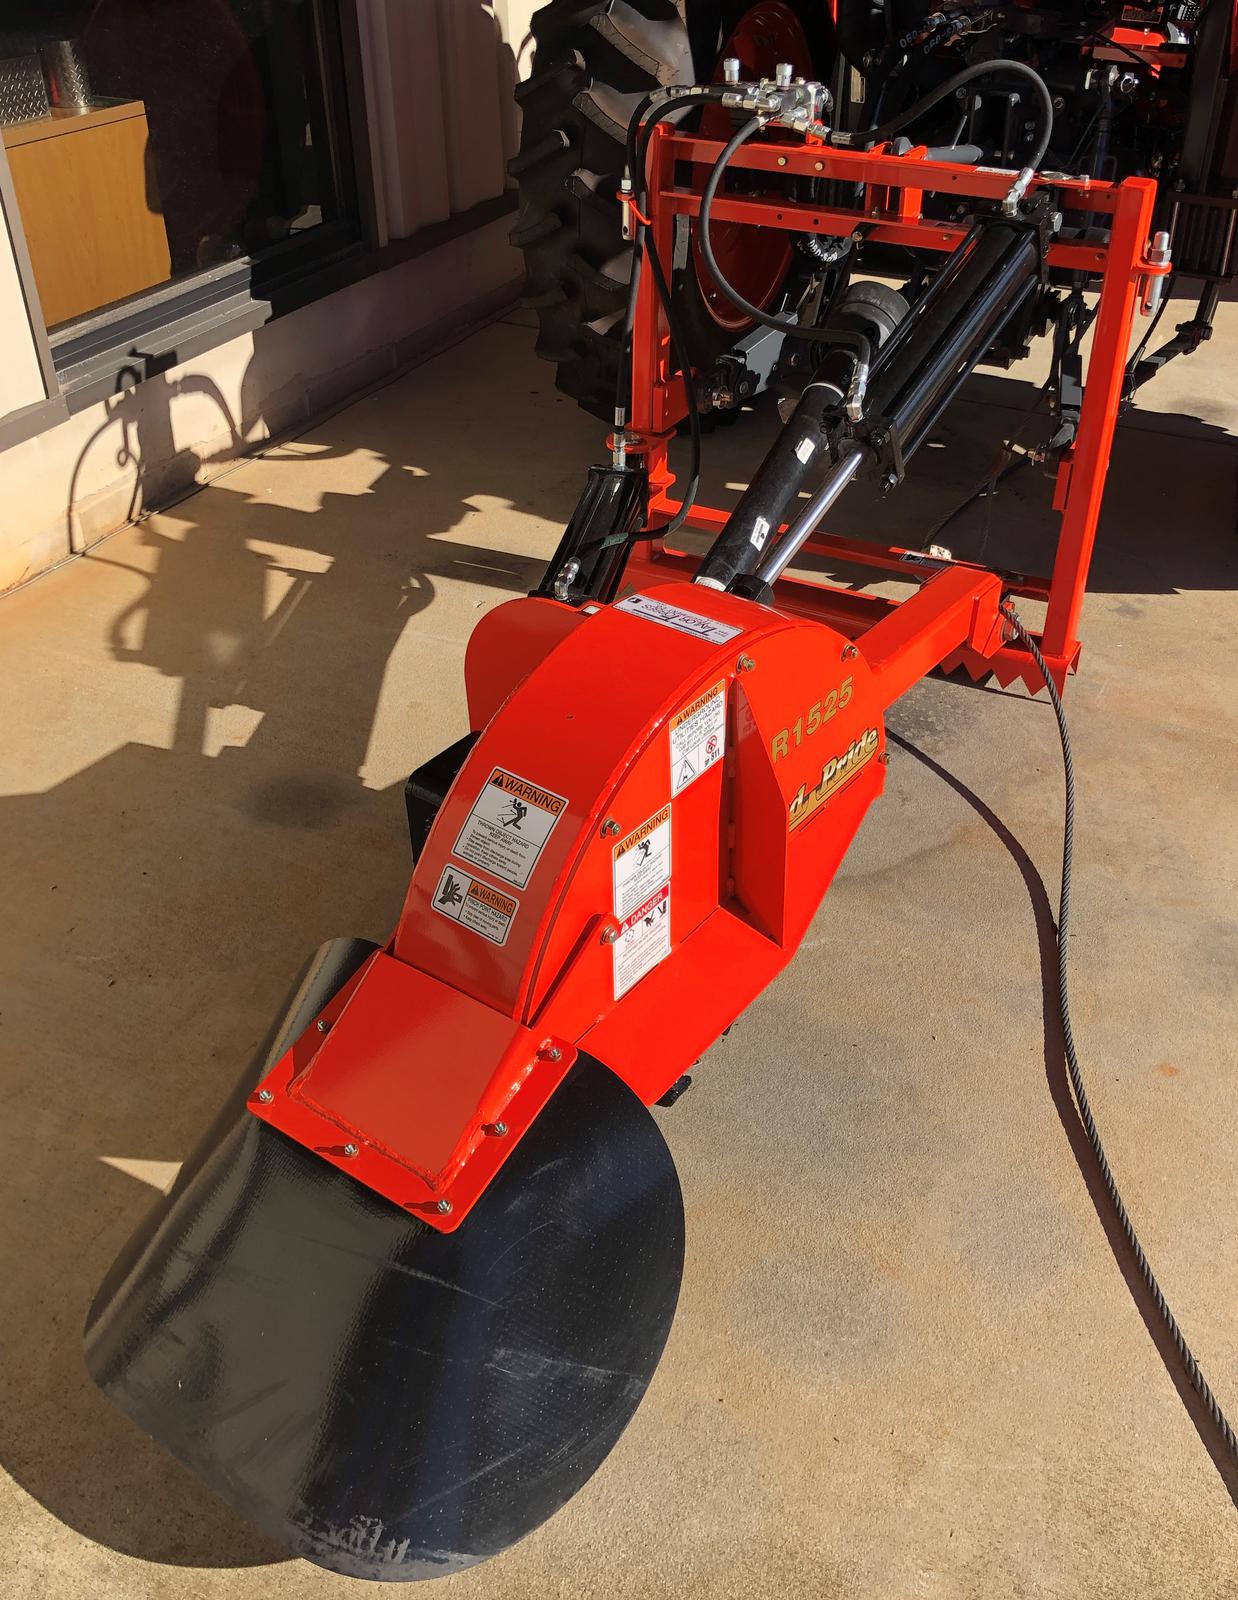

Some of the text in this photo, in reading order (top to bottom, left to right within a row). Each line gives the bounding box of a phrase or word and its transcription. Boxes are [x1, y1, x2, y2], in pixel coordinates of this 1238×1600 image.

[684, 687, 718, 717] WARNING
[771, 675, 853, 763] R1525
[818, 728, 878, 797] Pride
[505, 778, 561, 813] WARNING
[478, 820, 529, 849] THROWN OBJECT HAZARD
[489, 832, 501, 840] KEEP
[626, 809, 669, 846] WARNING
[480, 888, 513, 913] WARNING
[631, 893, 663, 922] DANGER
